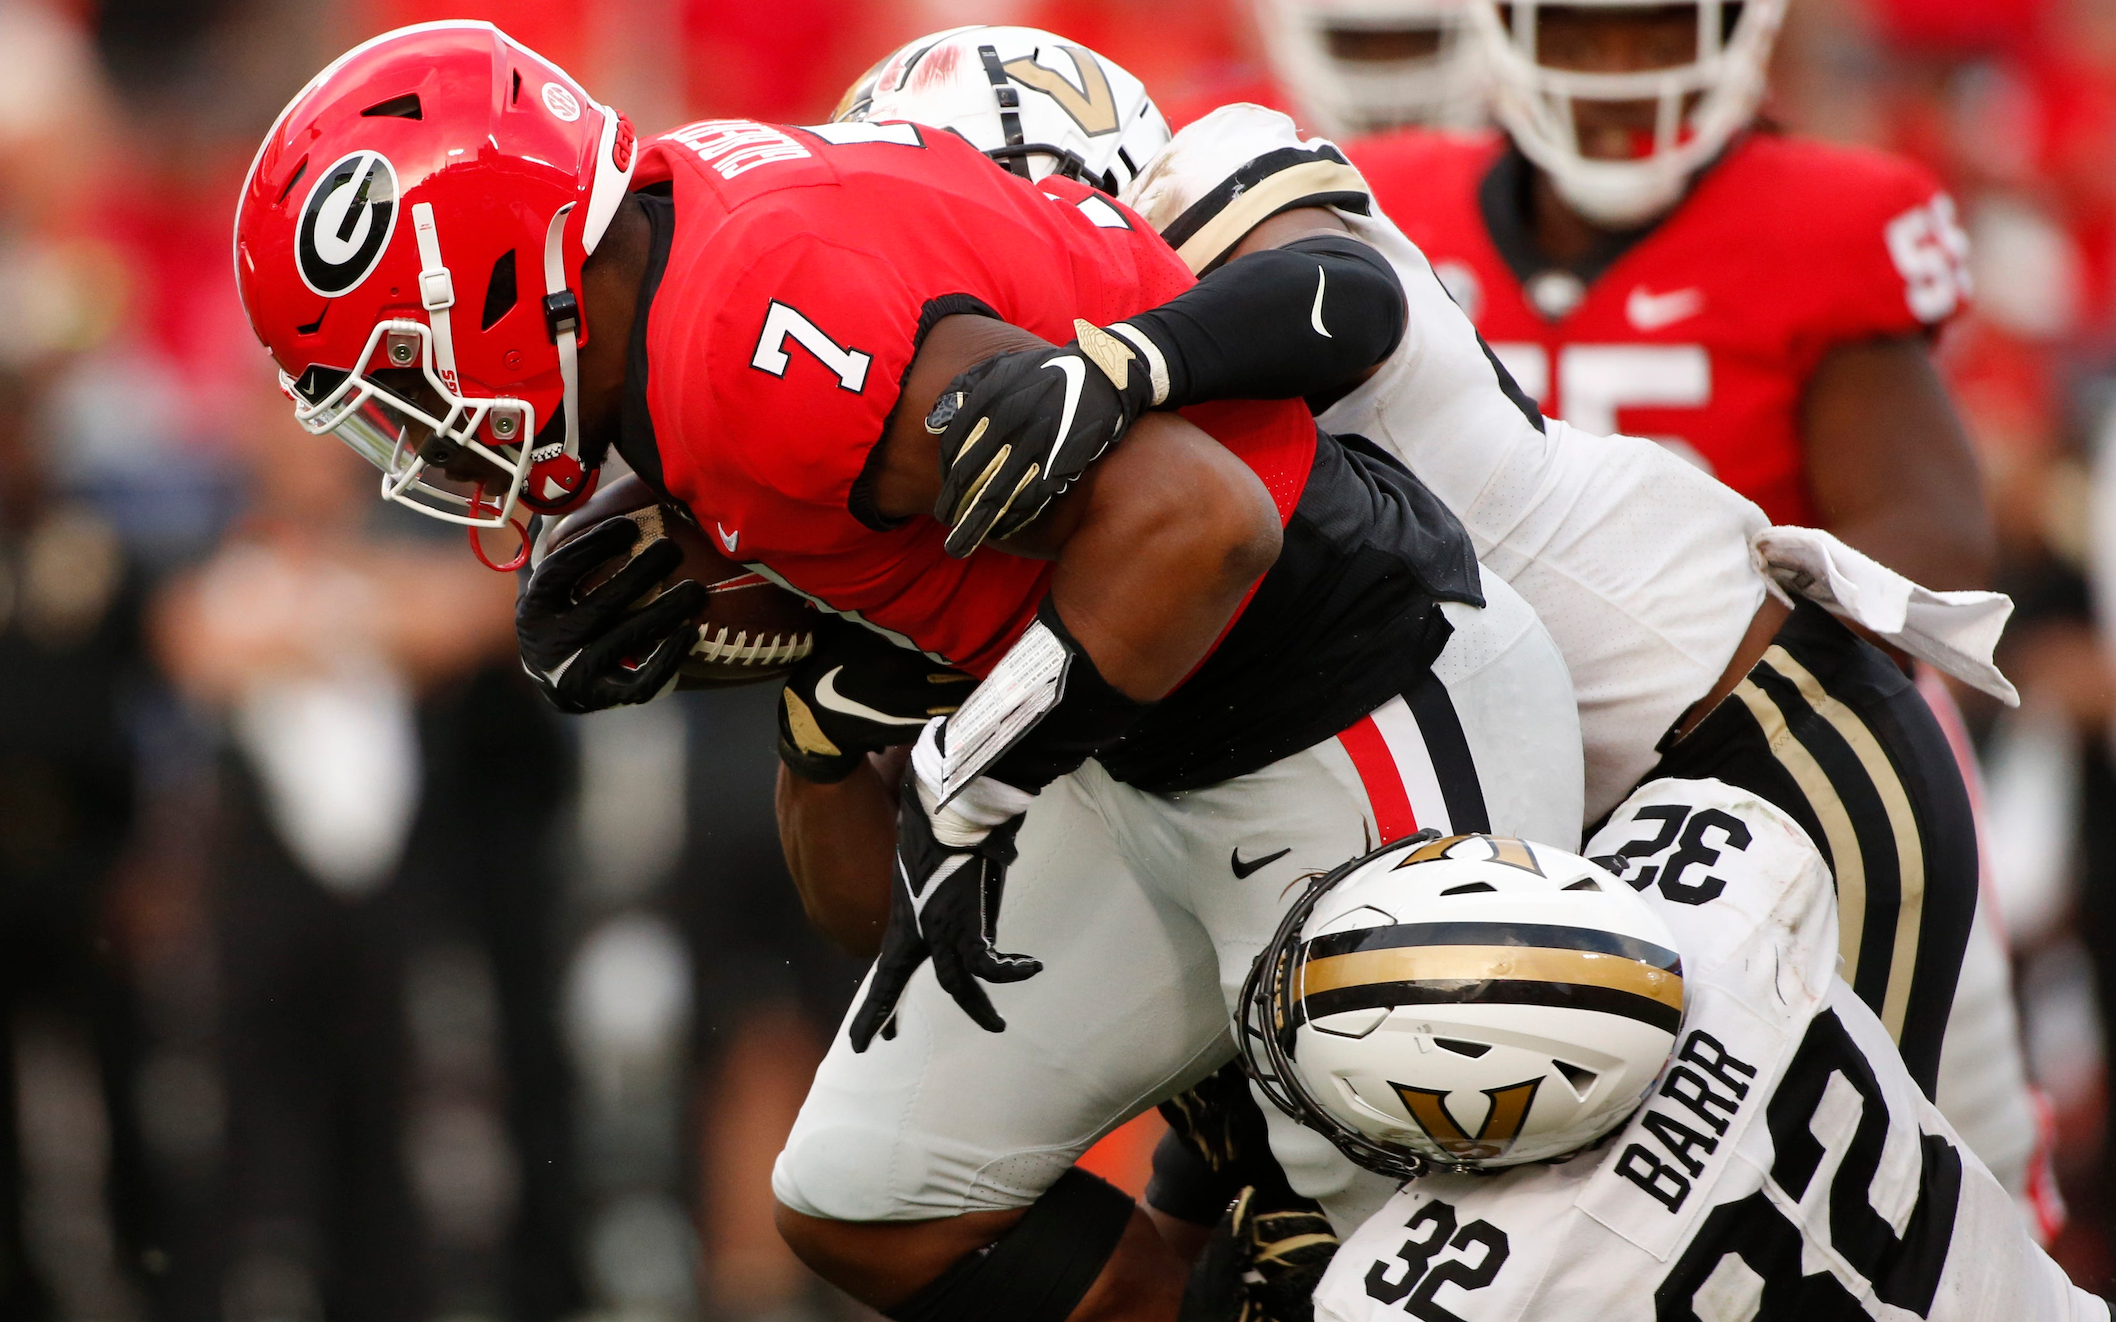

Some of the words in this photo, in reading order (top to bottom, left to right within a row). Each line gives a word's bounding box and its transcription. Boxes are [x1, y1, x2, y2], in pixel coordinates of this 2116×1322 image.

[749, 298, 874, 395] 7
[1588, 804, 1753, 906] 32
[1613, 1029, 1758, 1214] BARR
[1364, 1199, 1510, 1322] 32
